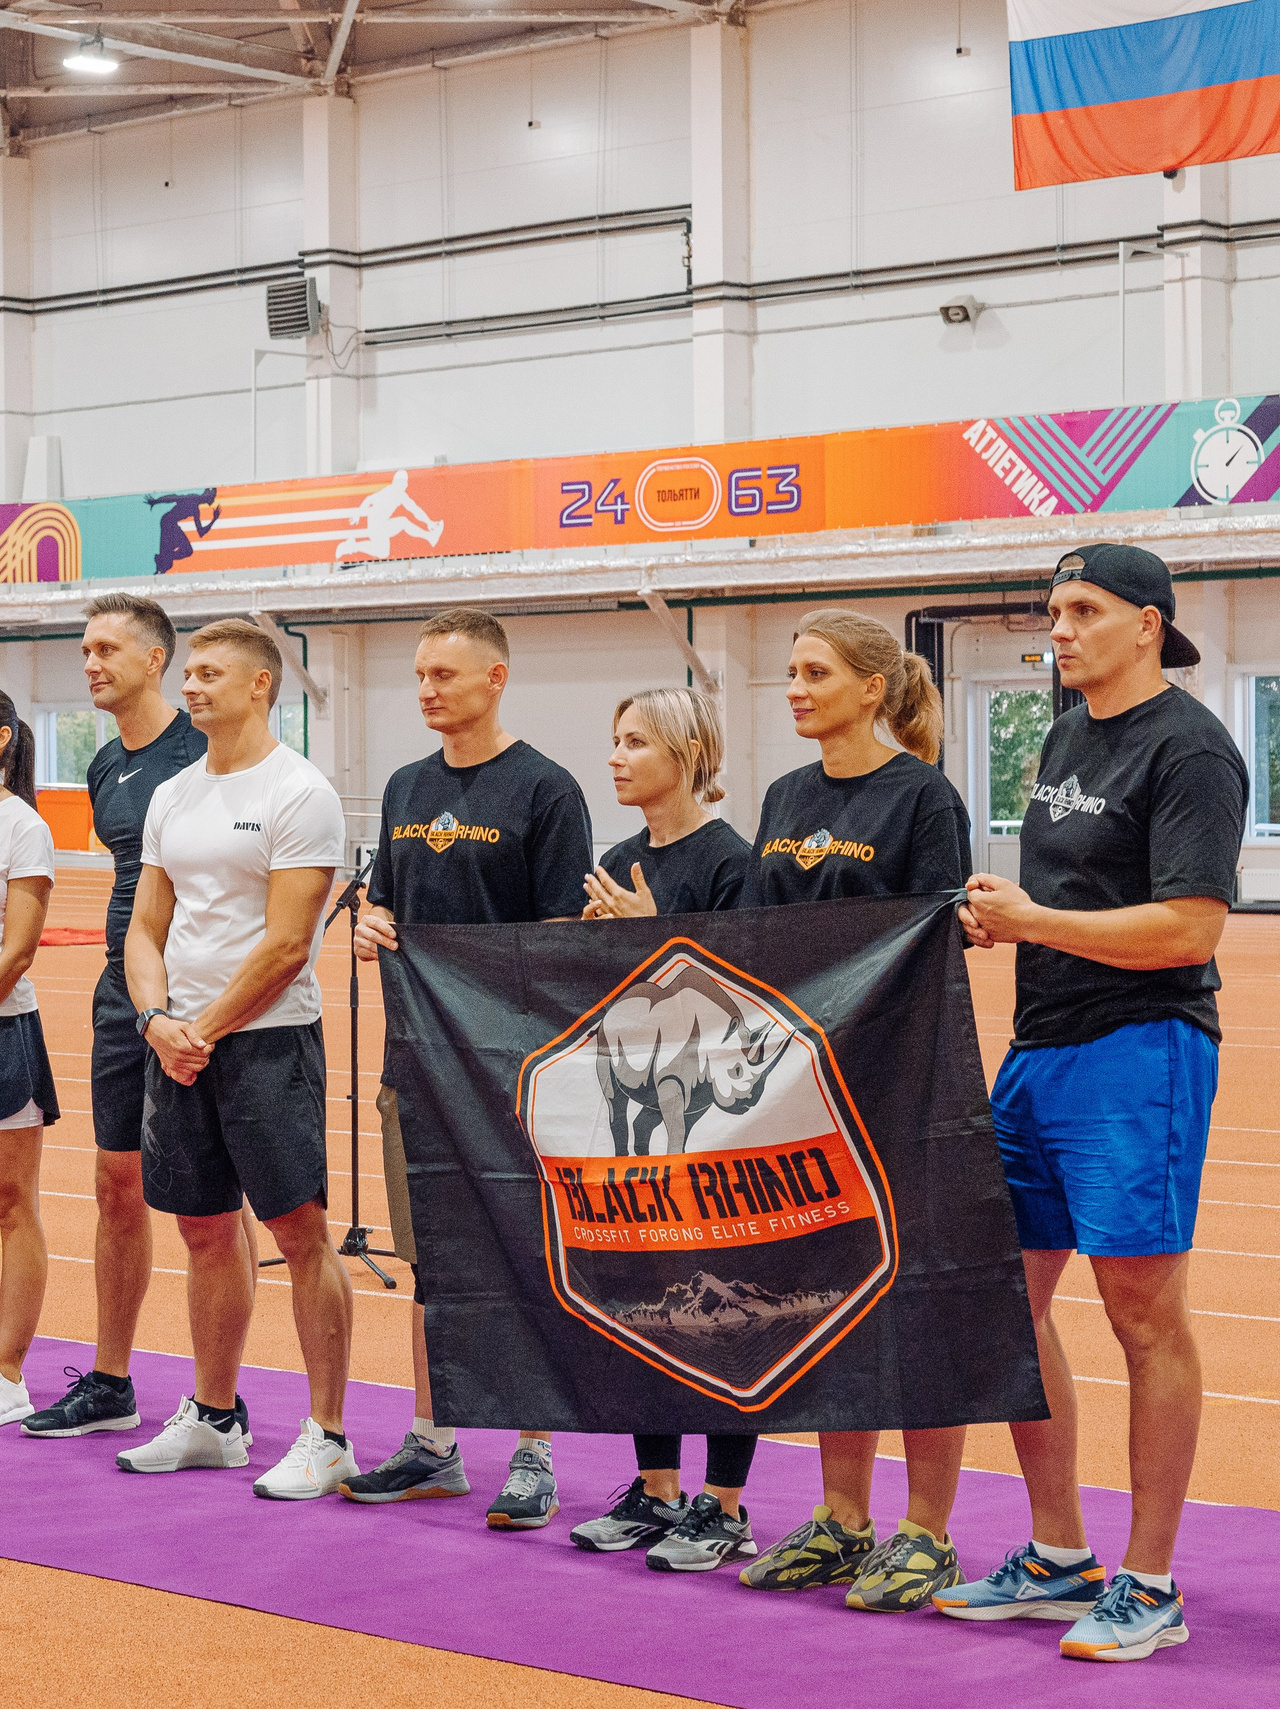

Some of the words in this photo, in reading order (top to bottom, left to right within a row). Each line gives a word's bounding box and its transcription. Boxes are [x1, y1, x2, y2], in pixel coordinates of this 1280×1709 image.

[962, 419, 1058, 517] АТЛЕТИКА
[560, 478, 630, 527] 24
[657, 487, 700, 502] ТОЛЬЯТТИ
[728, 464, 801, 516] 63
[233, 821, 262, 832] DAVIS
[392, 824, 429, 841] BLACK
[455, 825, 500, 844] RHINO
[826, 839, 875, 862] RHINO
[555, 1165, 684, 1224] BLACK
[686, 1147, 841, 1220] RHINO
[573, 1226, 631, 1243] CROSSFIT
[639, 1226, 704, 1243] FORGING
[711, 1221, 760, 1240] ELITE
[768, 1201, 851, 1232] FITNESS
